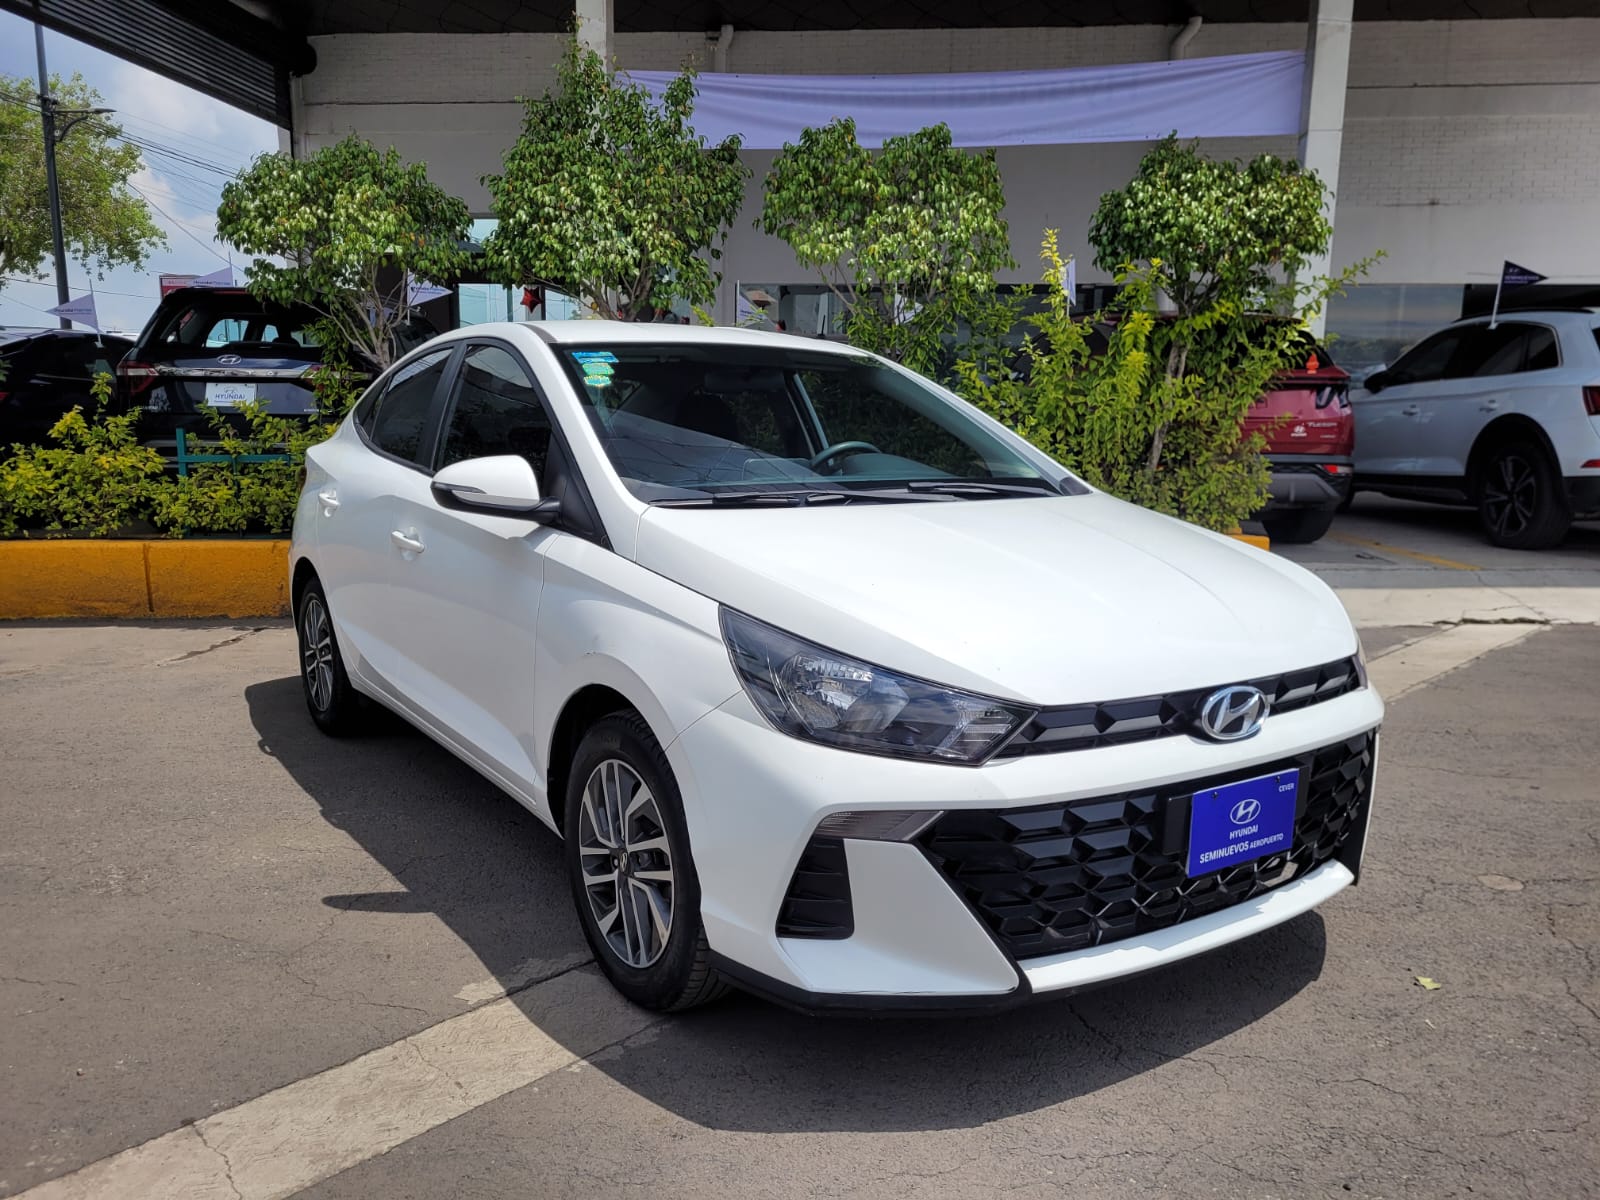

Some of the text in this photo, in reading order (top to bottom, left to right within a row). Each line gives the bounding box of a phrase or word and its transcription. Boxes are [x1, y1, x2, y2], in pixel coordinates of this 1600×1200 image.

[1278, 783, 1295, 792] CEVER
[1229, 824, 1259, 840] HYUNDAI
[1200, 833, 1284, 864] SEMINUEVOS AEROPUERTO
